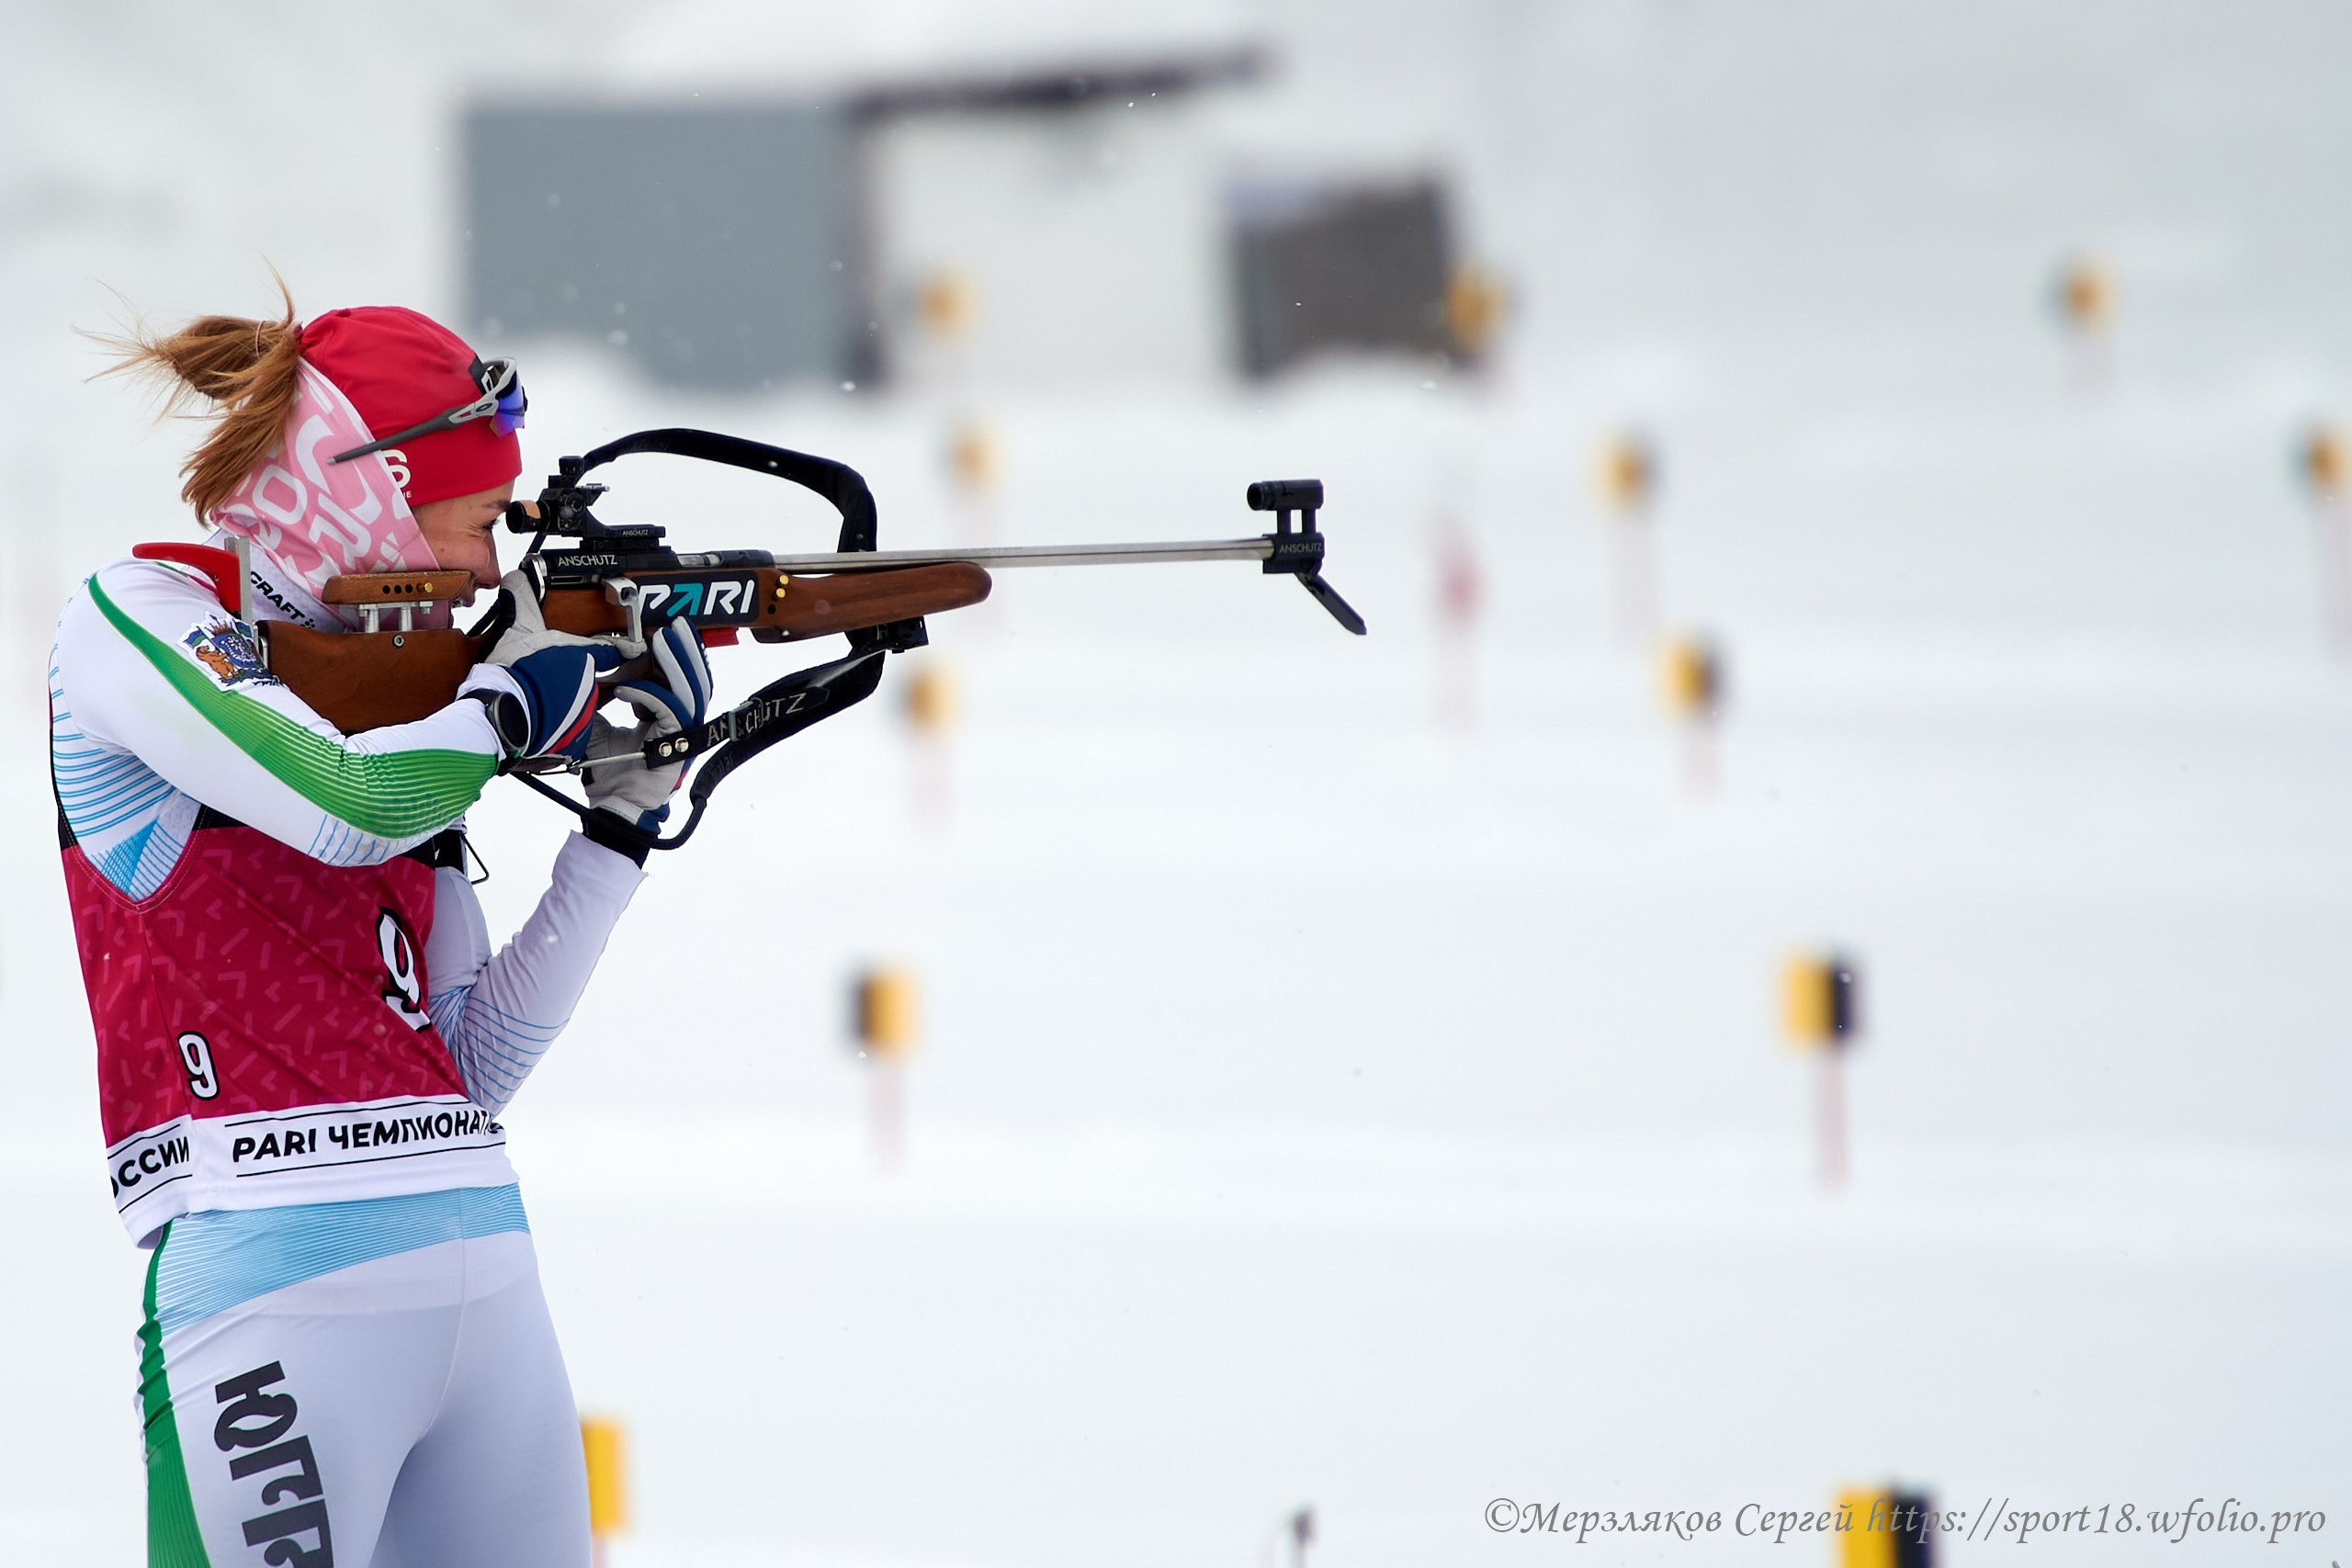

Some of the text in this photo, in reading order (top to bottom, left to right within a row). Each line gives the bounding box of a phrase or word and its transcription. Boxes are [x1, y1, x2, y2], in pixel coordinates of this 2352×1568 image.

[251, 570, 305, 620] CRAFT
[639, 580, 755, 617] PARI
[177, 1031, 220, 1100] 9
[232, 1128, 316, 1163] PARI
